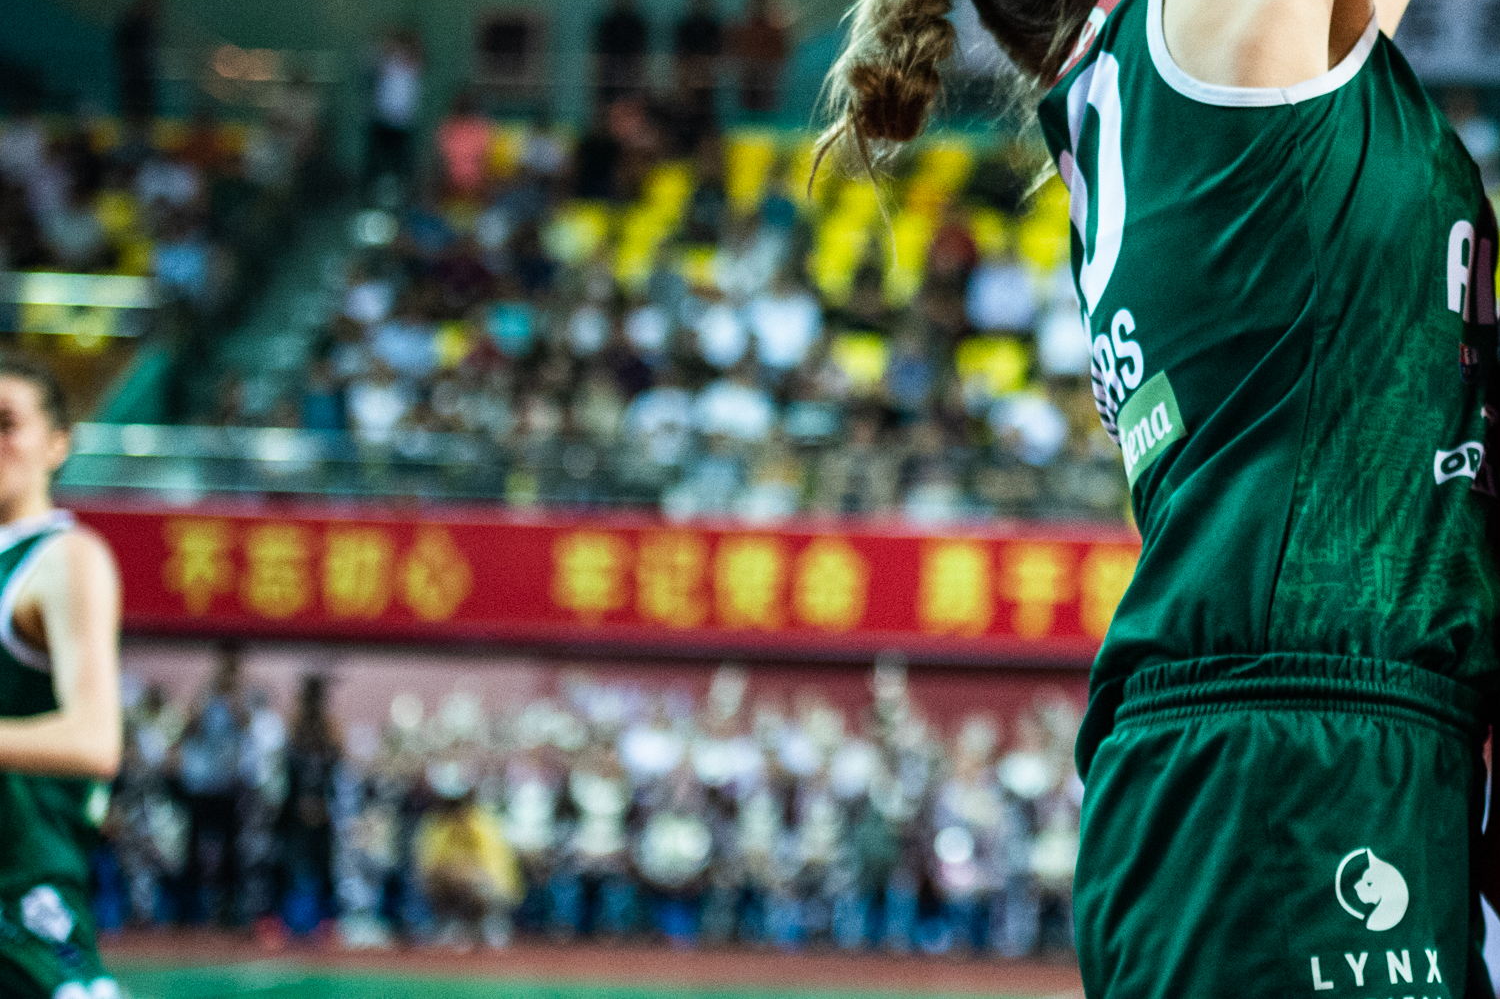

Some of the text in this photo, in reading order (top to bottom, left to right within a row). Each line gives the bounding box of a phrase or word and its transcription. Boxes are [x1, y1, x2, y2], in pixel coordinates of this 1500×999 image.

[163, 519, 471, 619] 不忘初心
[1310, 948, 1442, 991] LYNX
